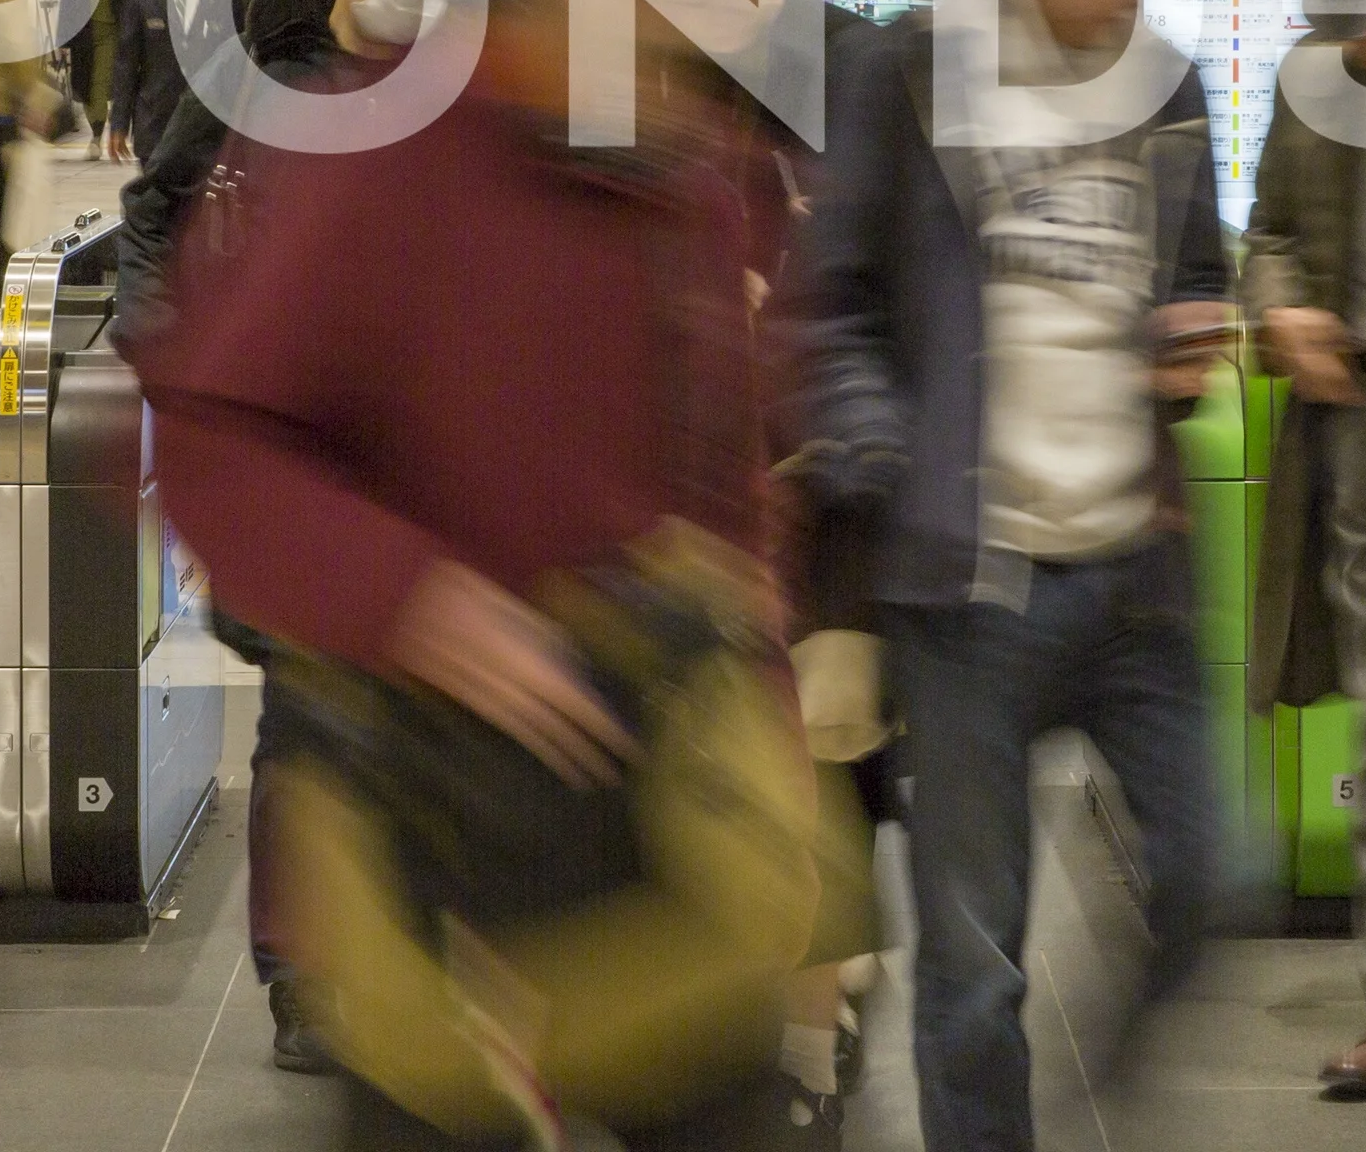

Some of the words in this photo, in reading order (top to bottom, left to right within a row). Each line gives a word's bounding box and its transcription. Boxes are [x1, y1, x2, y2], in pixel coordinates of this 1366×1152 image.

[1, 361, 15, 413] 扉にご注意
[86, 785, 100, 804] 3
[1339, 778, 1354, 800] 5
